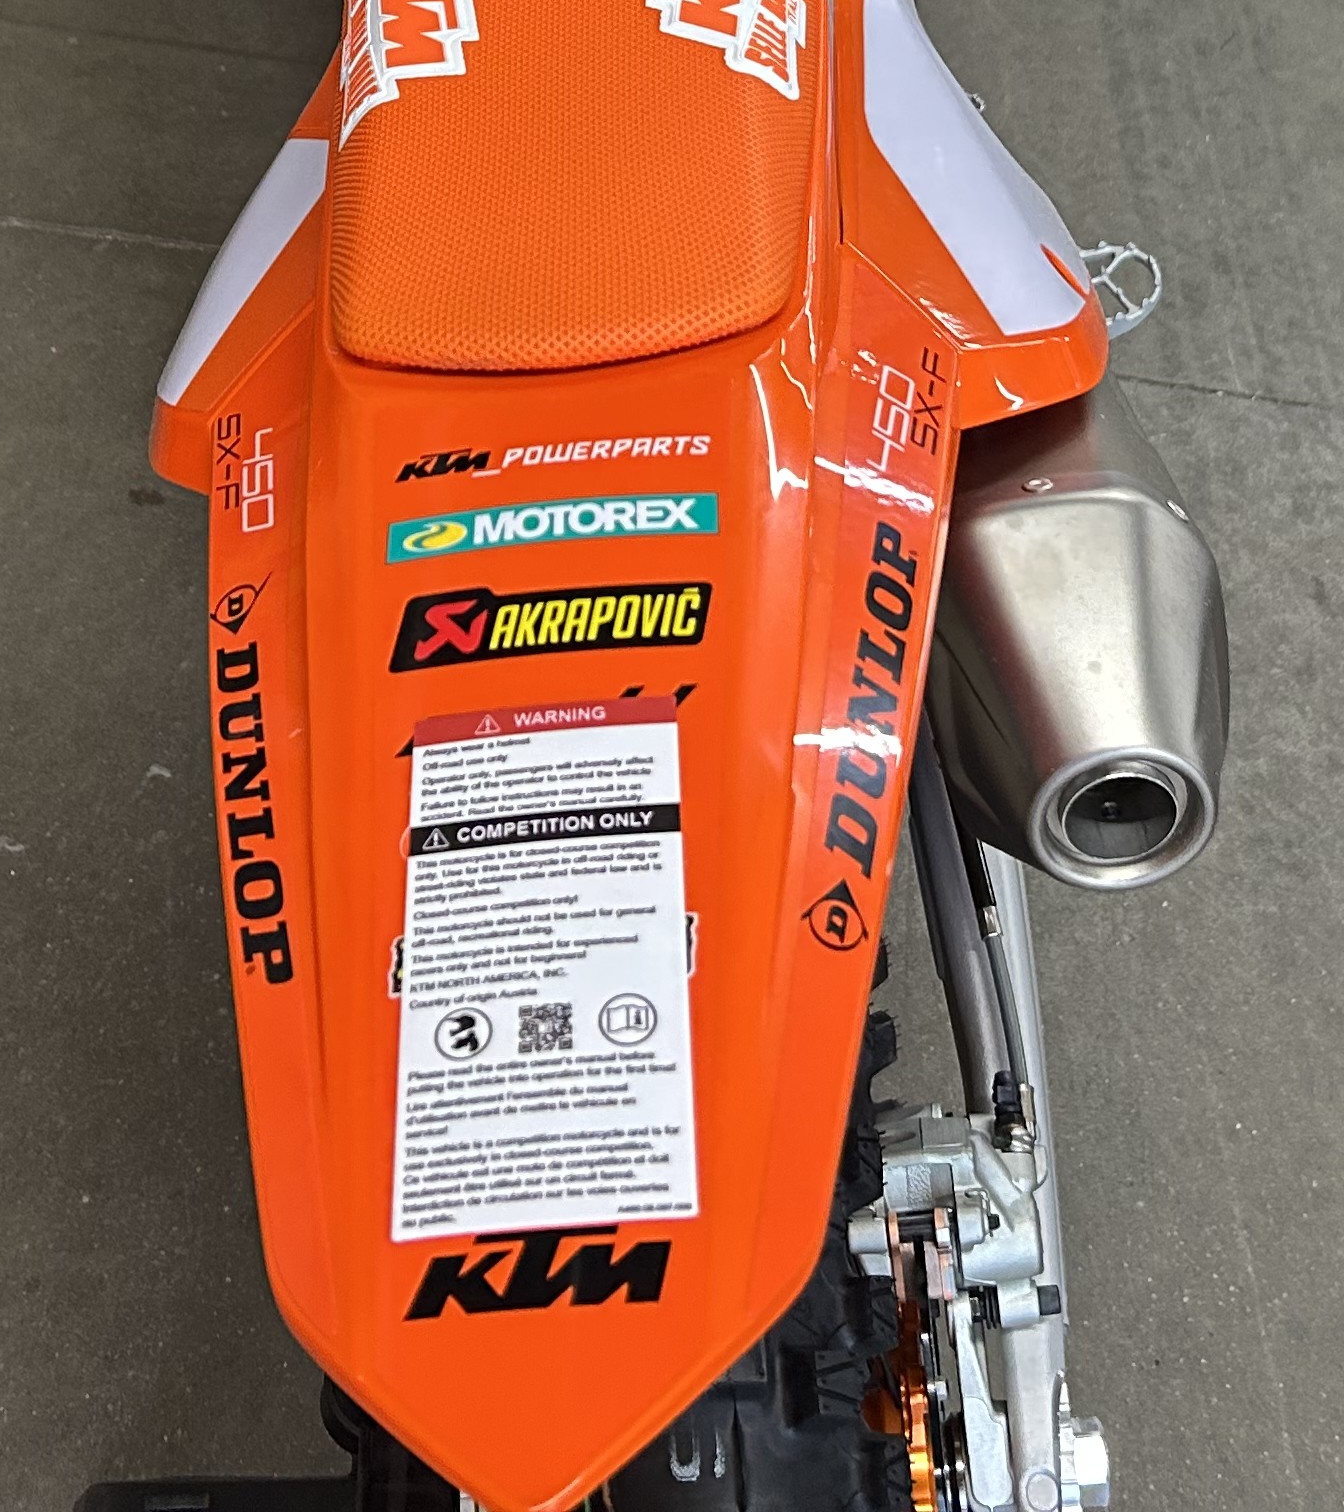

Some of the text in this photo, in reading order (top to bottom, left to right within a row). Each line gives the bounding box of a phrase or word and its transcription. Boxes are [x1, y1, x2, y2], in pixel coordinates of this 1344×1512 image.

[865, 365, 916, 473] 450
[910, 347, 947, 456] SX-F
[216, 413, 241, 509] SX-F
[241, 427, 275, 533] 450
[394, 447, 491, 483] KTM
[472, 497, 698, 546] MOTOREX
[489, 586, 701, 651] AKRAPOVIČ
[513, 705, 606, 728] WARNING
[824, 521, 918, 879] DUNLOP
[216, 641, 294, 985] DUNLOP
[456, 810, 653, 844] COMPETITION ONLY
[402, 1224, 672, 1322] KTM
